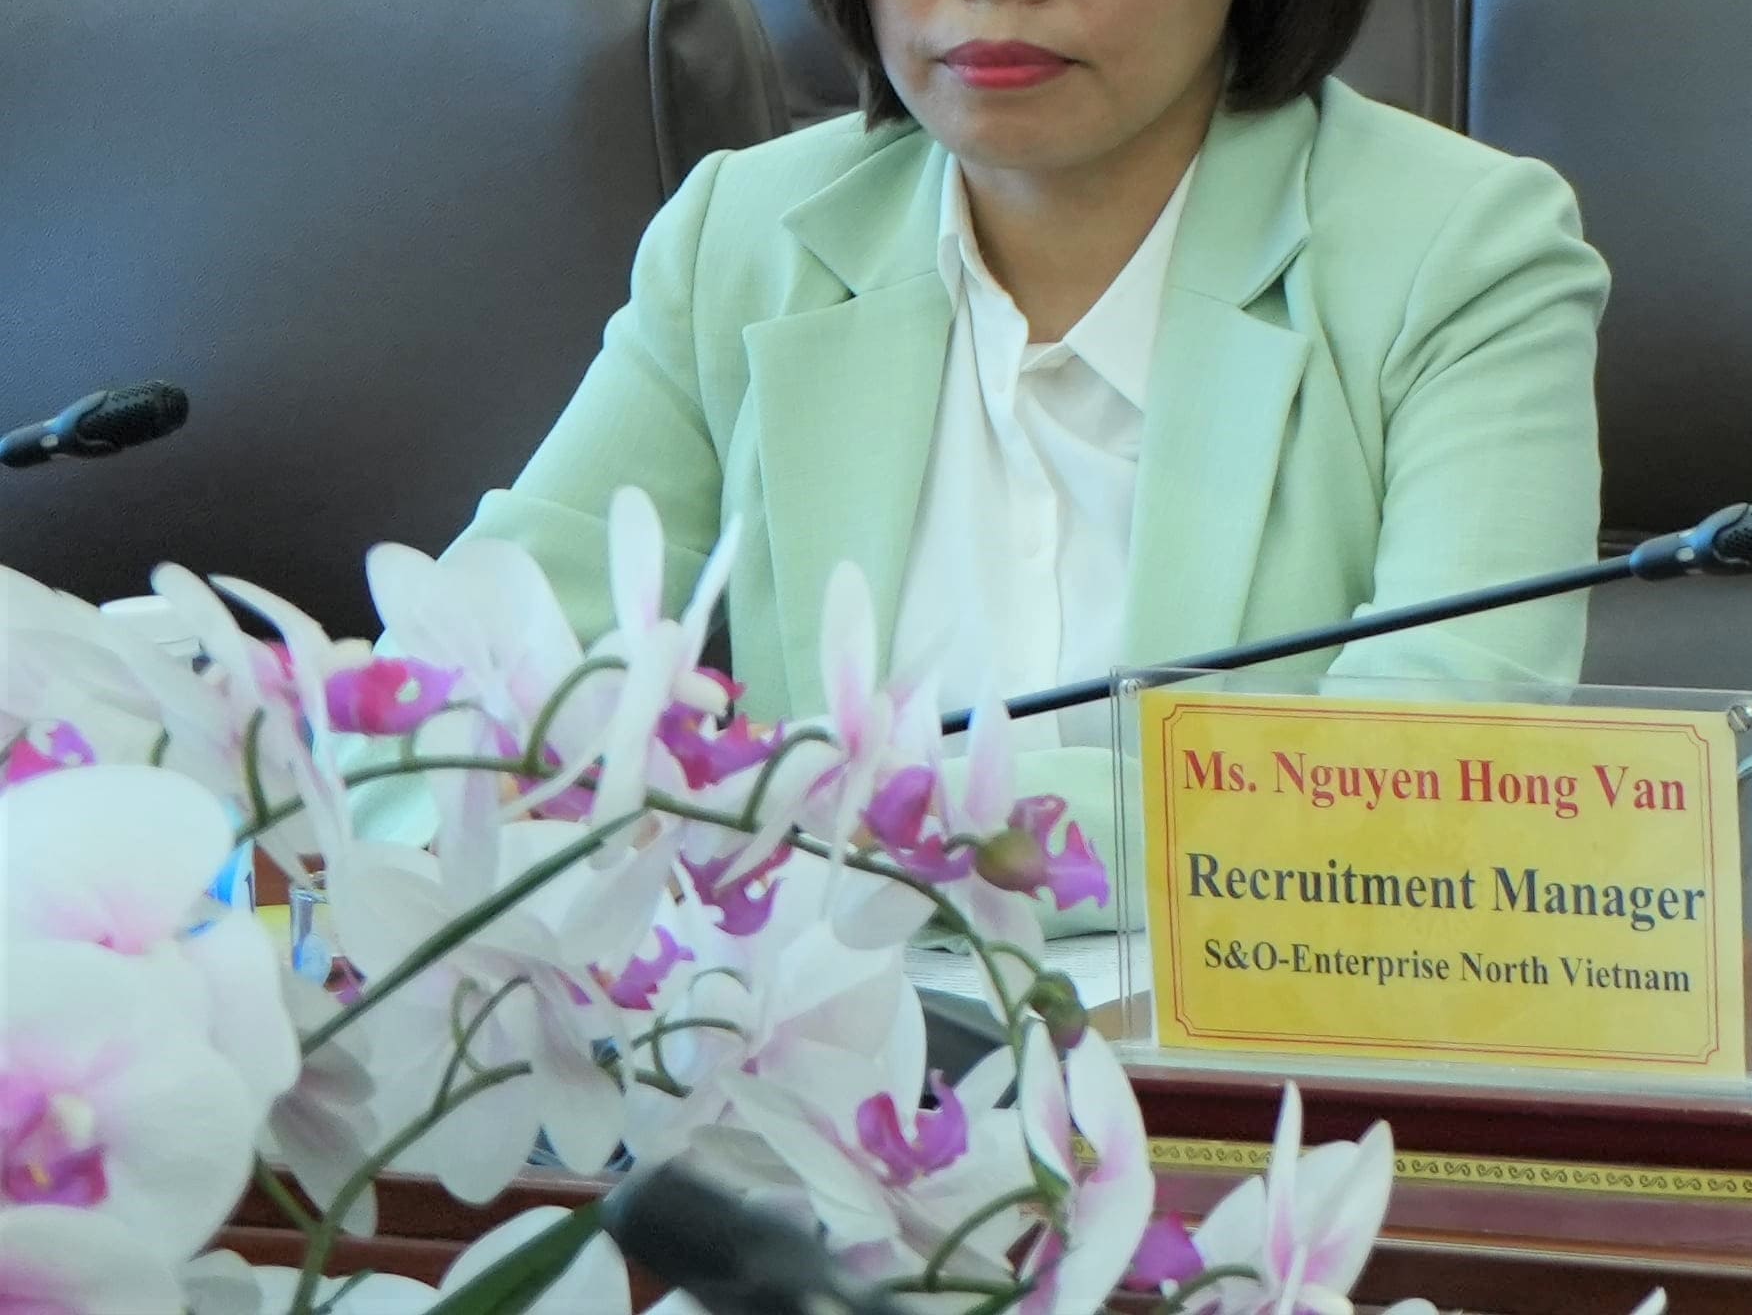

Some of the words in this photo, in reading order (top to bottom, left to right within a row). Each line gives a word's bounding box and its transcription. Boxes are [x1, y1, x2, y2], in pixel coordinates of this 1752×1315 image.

[1181, 747, 1258, 794] Ms.
[1270, 750, 1443, 813] Nguyen
[1457, 757, 1580, 820] Hong
[1592, 763, 1687, 813] Van
[1186, 850, 1477, 912] Recruitment
[1491, 865, 1706, 931] Manager
[1203, 937, 1452, 989] S&O-Enterprise
[1458, 951, 1550, 986] North
[1560, 955, 1691, 994] Vietnam
